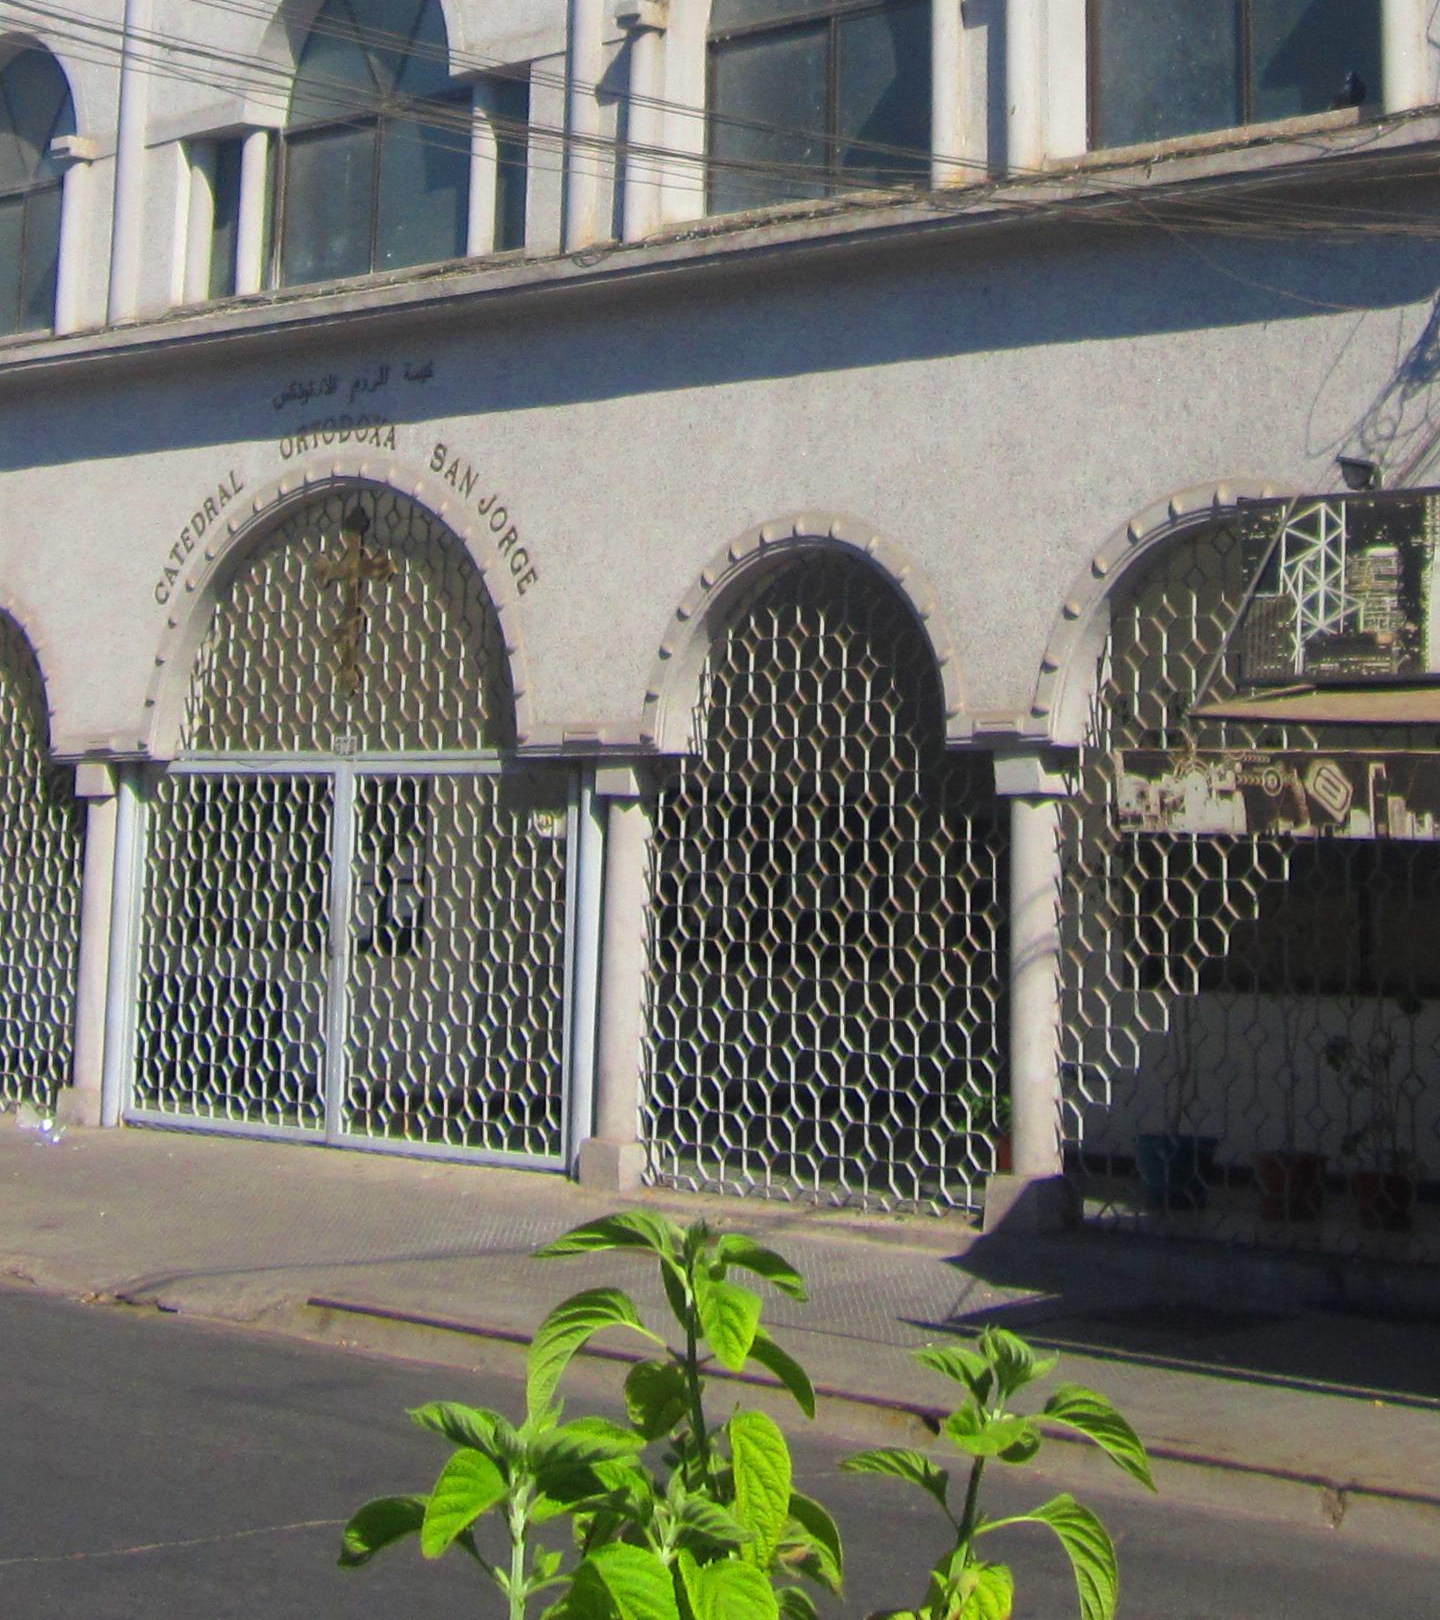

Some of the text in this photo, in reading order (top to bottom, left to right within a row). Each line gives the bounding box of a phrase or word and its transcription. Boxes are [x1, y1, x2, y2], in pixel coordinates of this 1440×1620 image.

[154, 414, 540, 606] CATEDRAL ORTODOXA SAN JORGE
